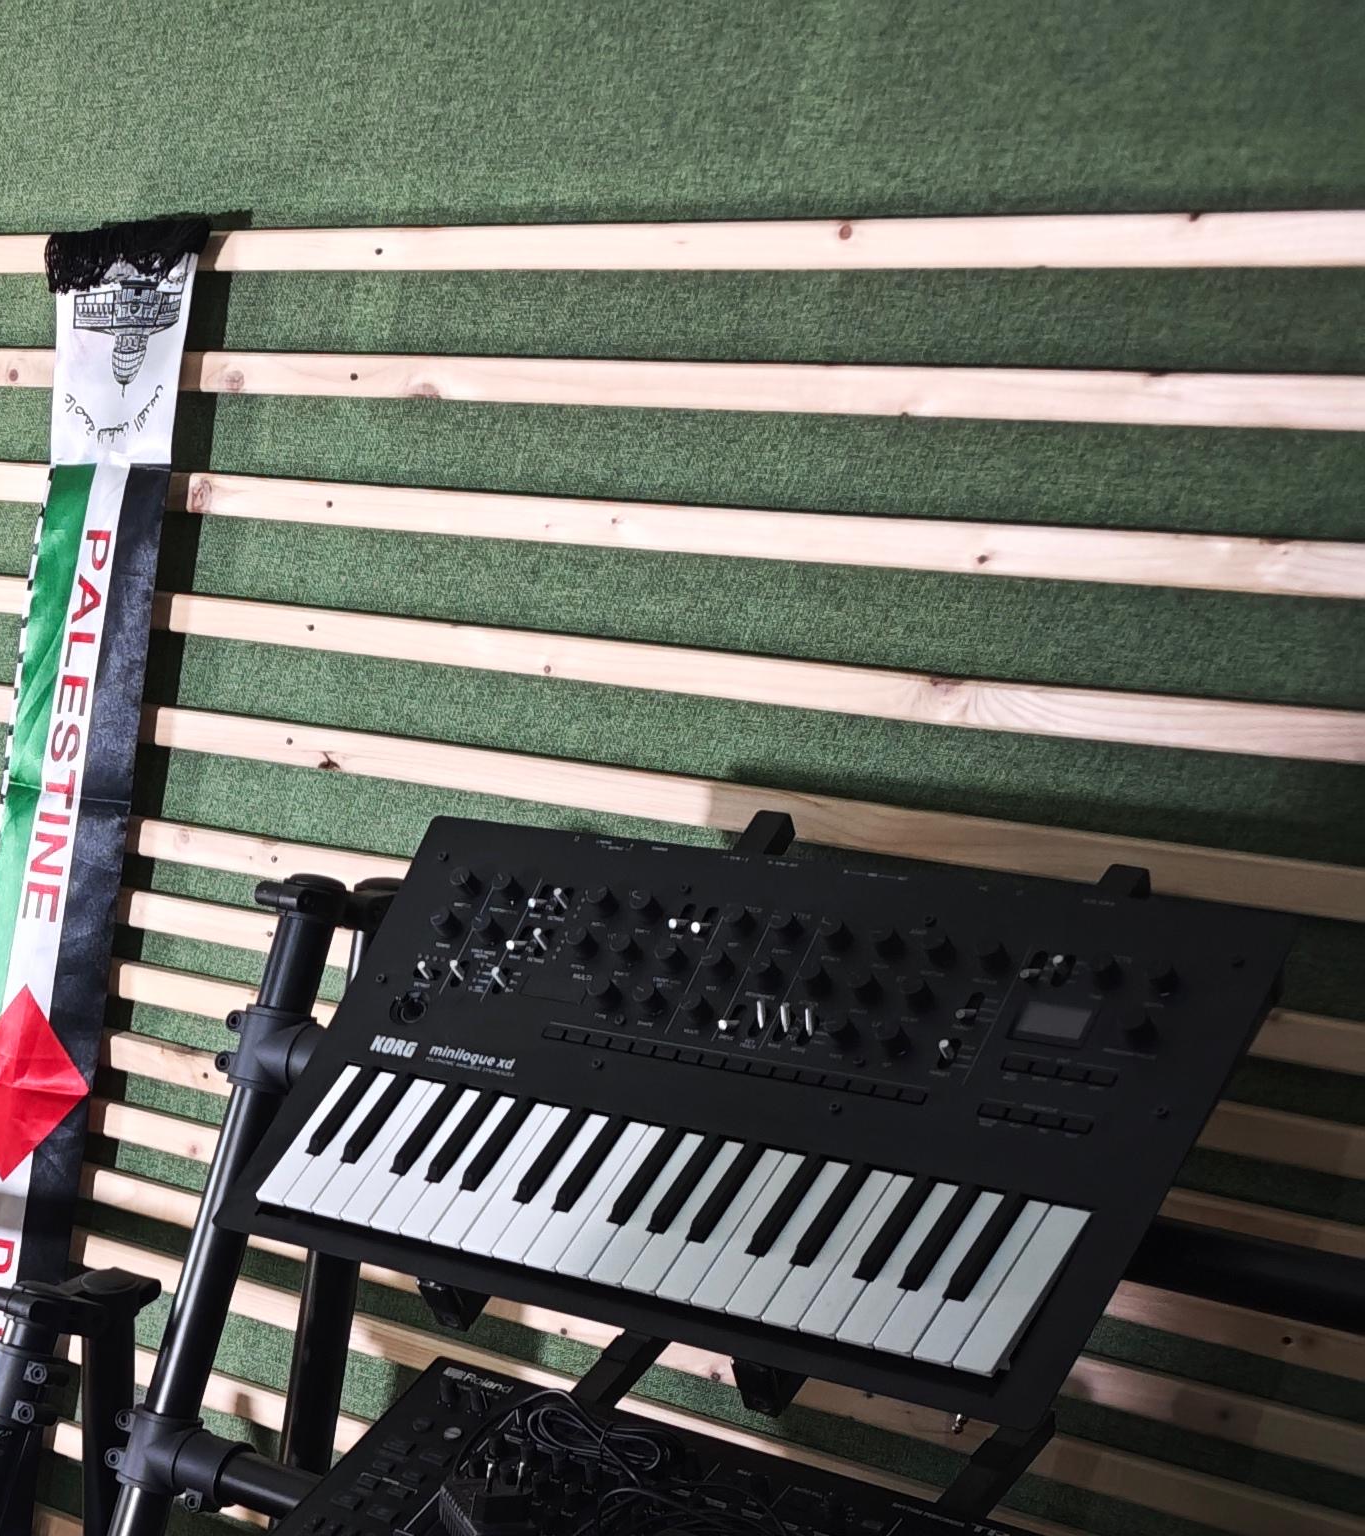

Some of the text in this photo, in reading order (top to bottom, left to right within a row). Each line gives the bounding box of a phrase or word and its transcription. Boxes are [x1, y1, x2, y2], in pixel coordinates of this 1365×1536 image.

[134, 385, 163, 432] القدس
[22, 529, 112, 923] PALESTINE
[370, 1035, 516, 1070] KORG minilogue xd
[463, 1373, 514, 1394] Roland
